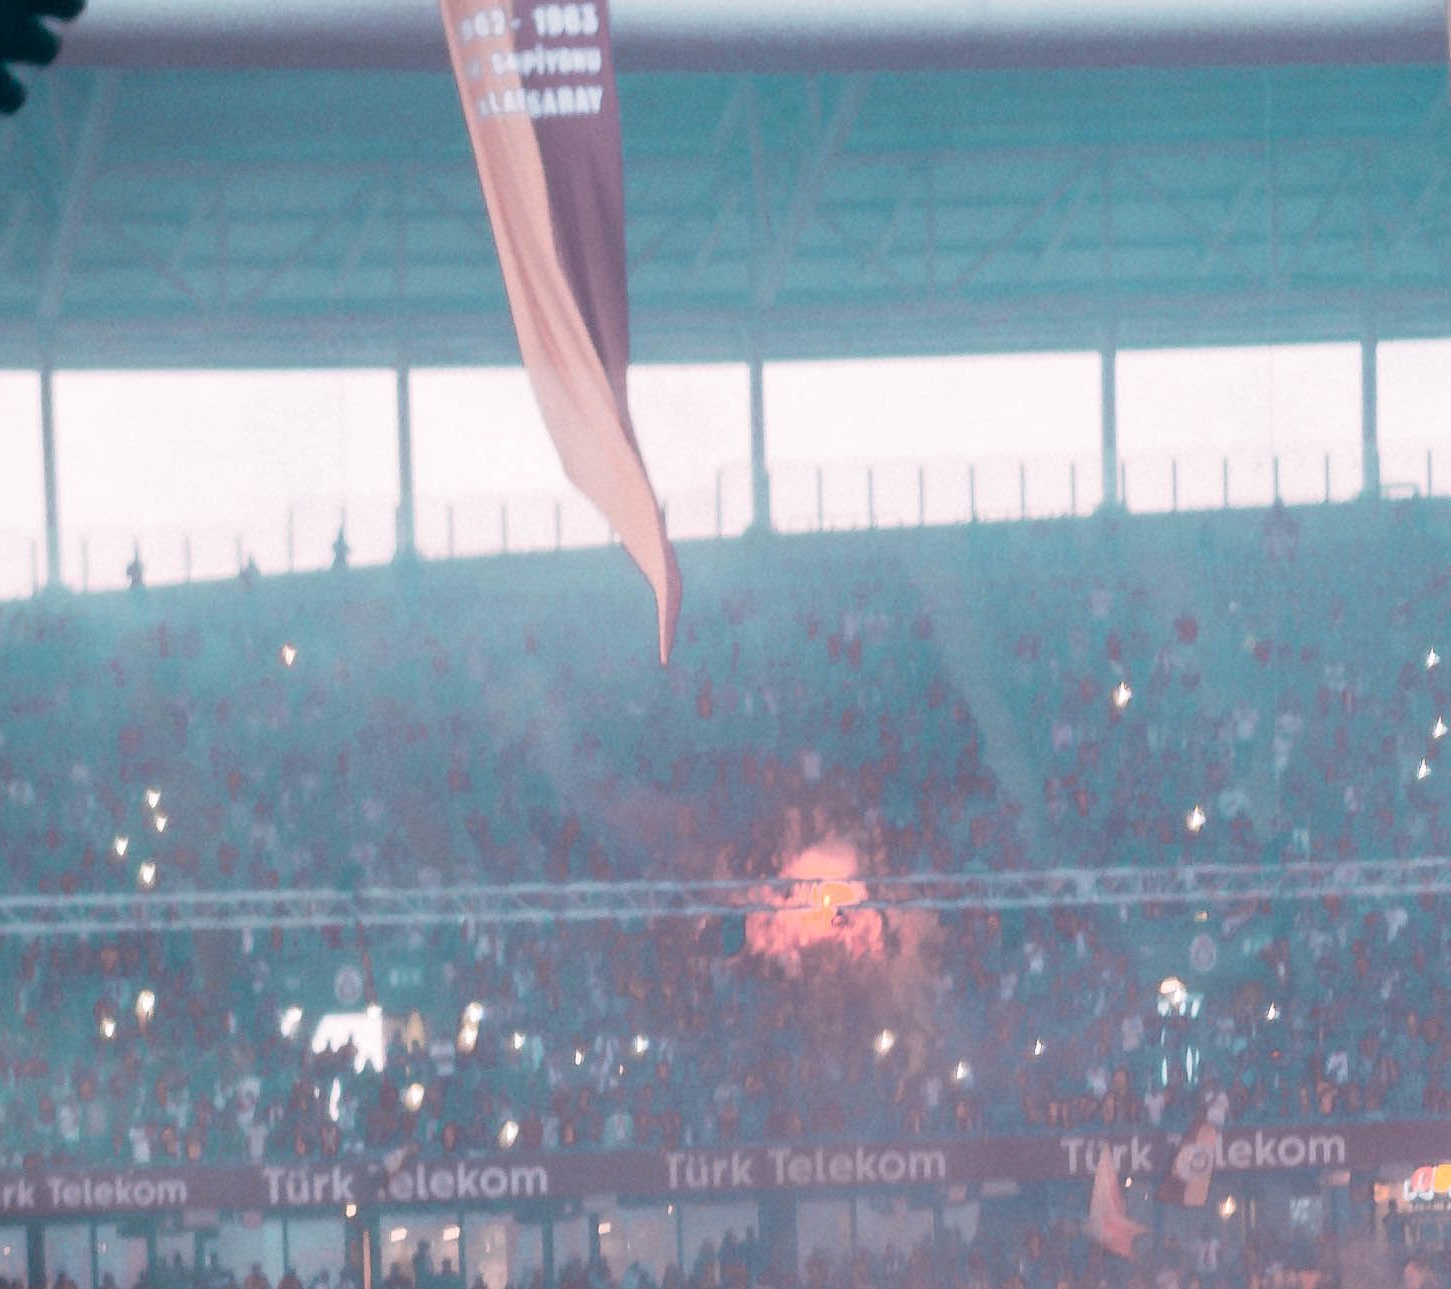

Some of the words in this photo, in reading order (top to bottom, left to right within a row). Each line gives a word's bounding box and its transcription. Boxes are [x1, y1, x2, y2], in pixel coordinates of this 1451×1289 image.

[665, 1150, 753, 1191] Türk
[765, 1146, 948, 1188] Telekom
[1059, 1136, 1154, 1176] Türk
[47, 1174, 189, 1211] Telekom
[263, 1167, 355, 1206] Türk
[372, 1162, 549, 1204] elekom
